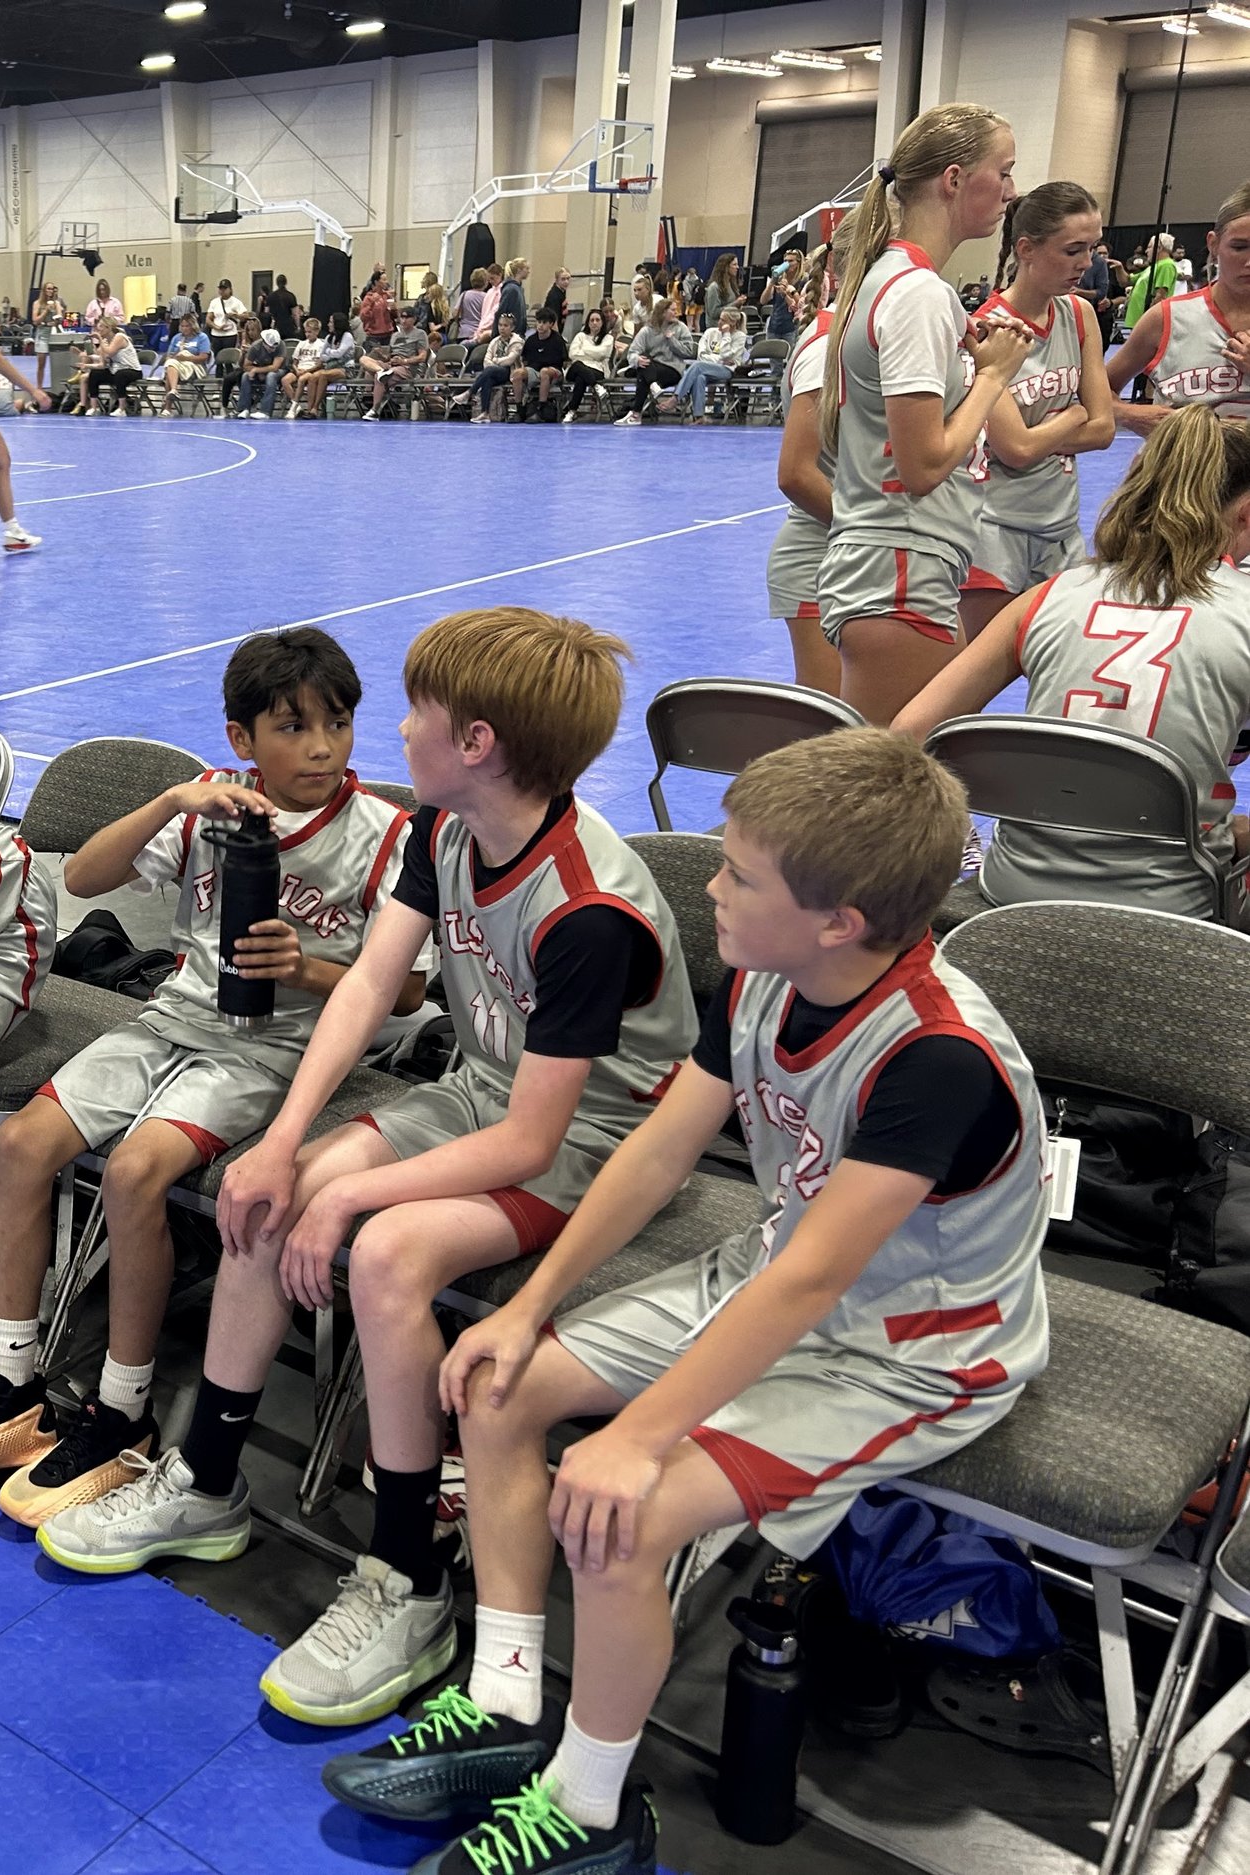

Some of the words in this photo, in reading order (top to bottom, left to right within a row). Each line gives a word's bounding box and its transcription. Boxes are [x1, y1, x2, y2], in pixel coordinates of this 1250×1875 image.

[125, 254, 153, 268] Men
[1062, 601, 1192, 738] 3
[194, 868, 349, 938] FION
[471, 991, 508, 1064] 11
